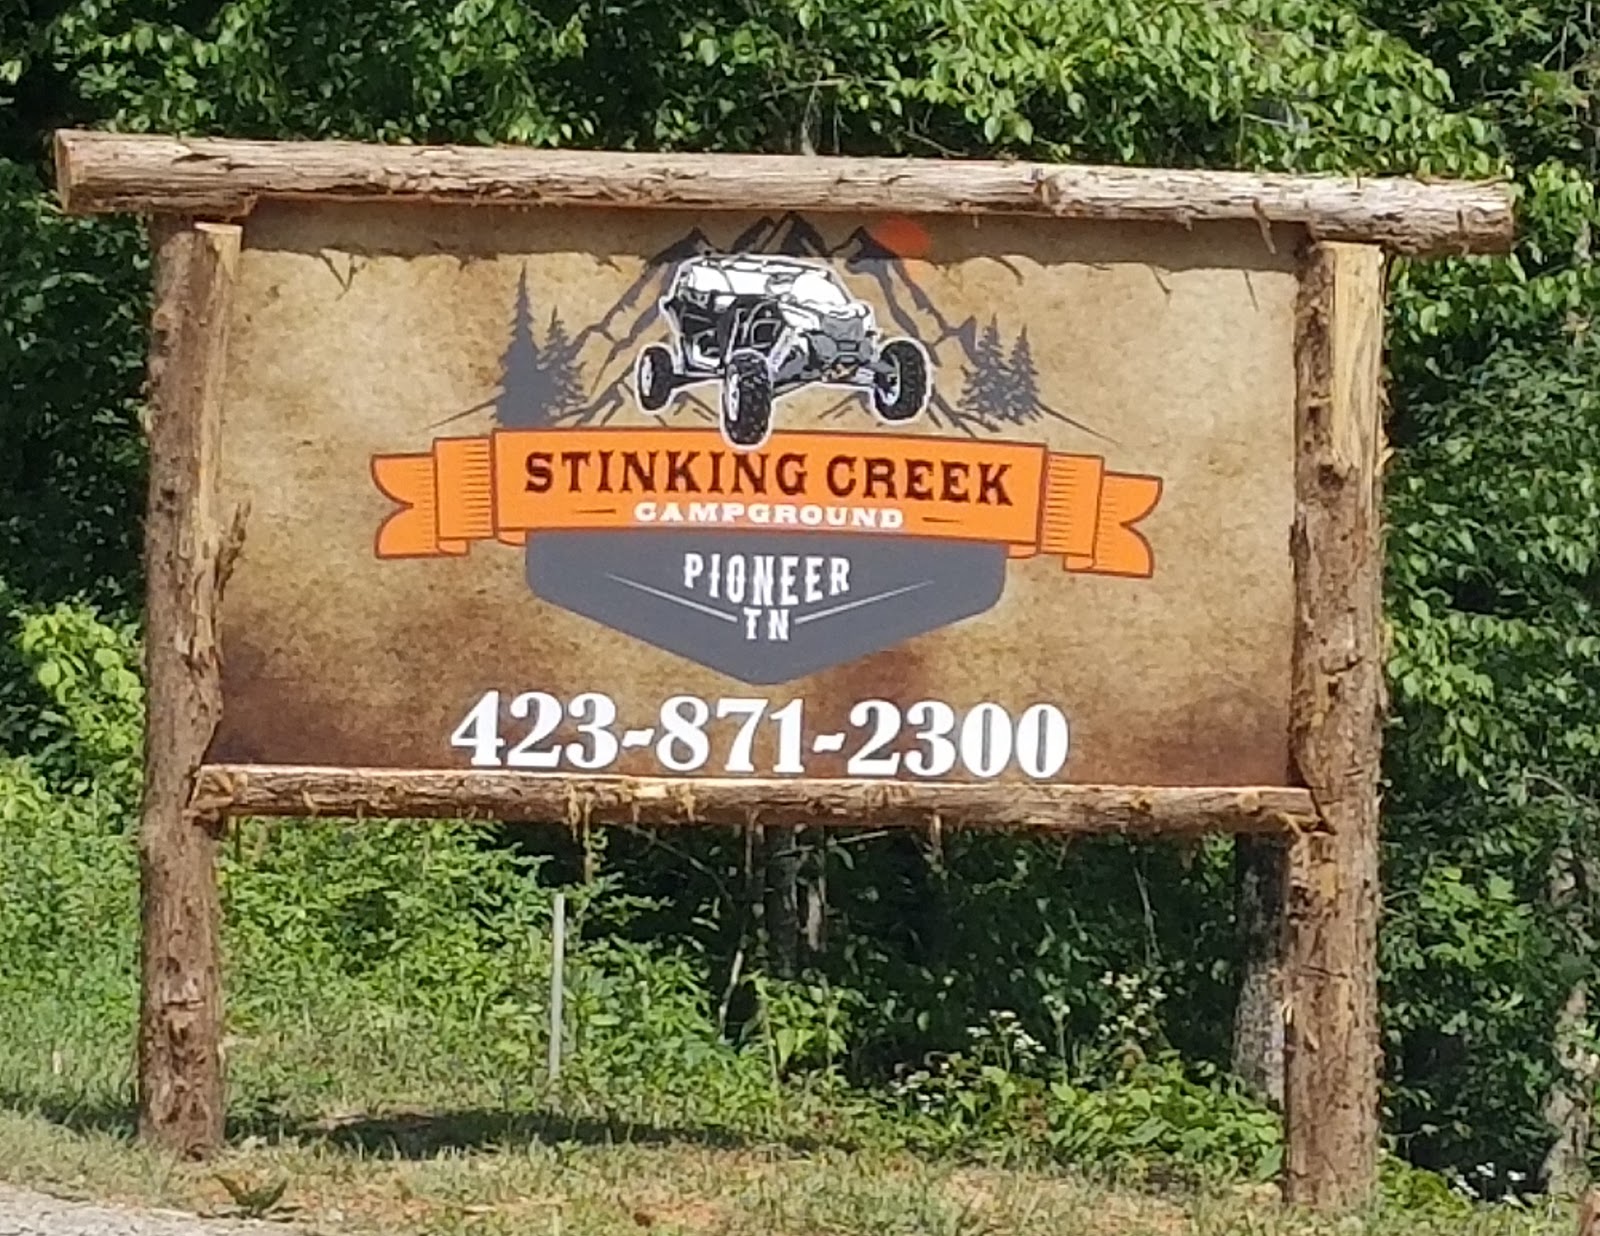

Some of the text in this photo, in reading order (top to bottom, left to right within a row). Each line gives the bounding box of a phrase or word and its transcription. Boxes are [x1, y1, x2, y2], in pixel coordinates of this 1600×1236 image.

[524, 449, 1014, 506] STINKING CREEK
[633, 501, 905, 530] CAMPGROUND
[683, 552, 852, 606] PIONEER
[743, 608, 790, 642] TN
[450, 689, 1070, 778] 423-871-2300
